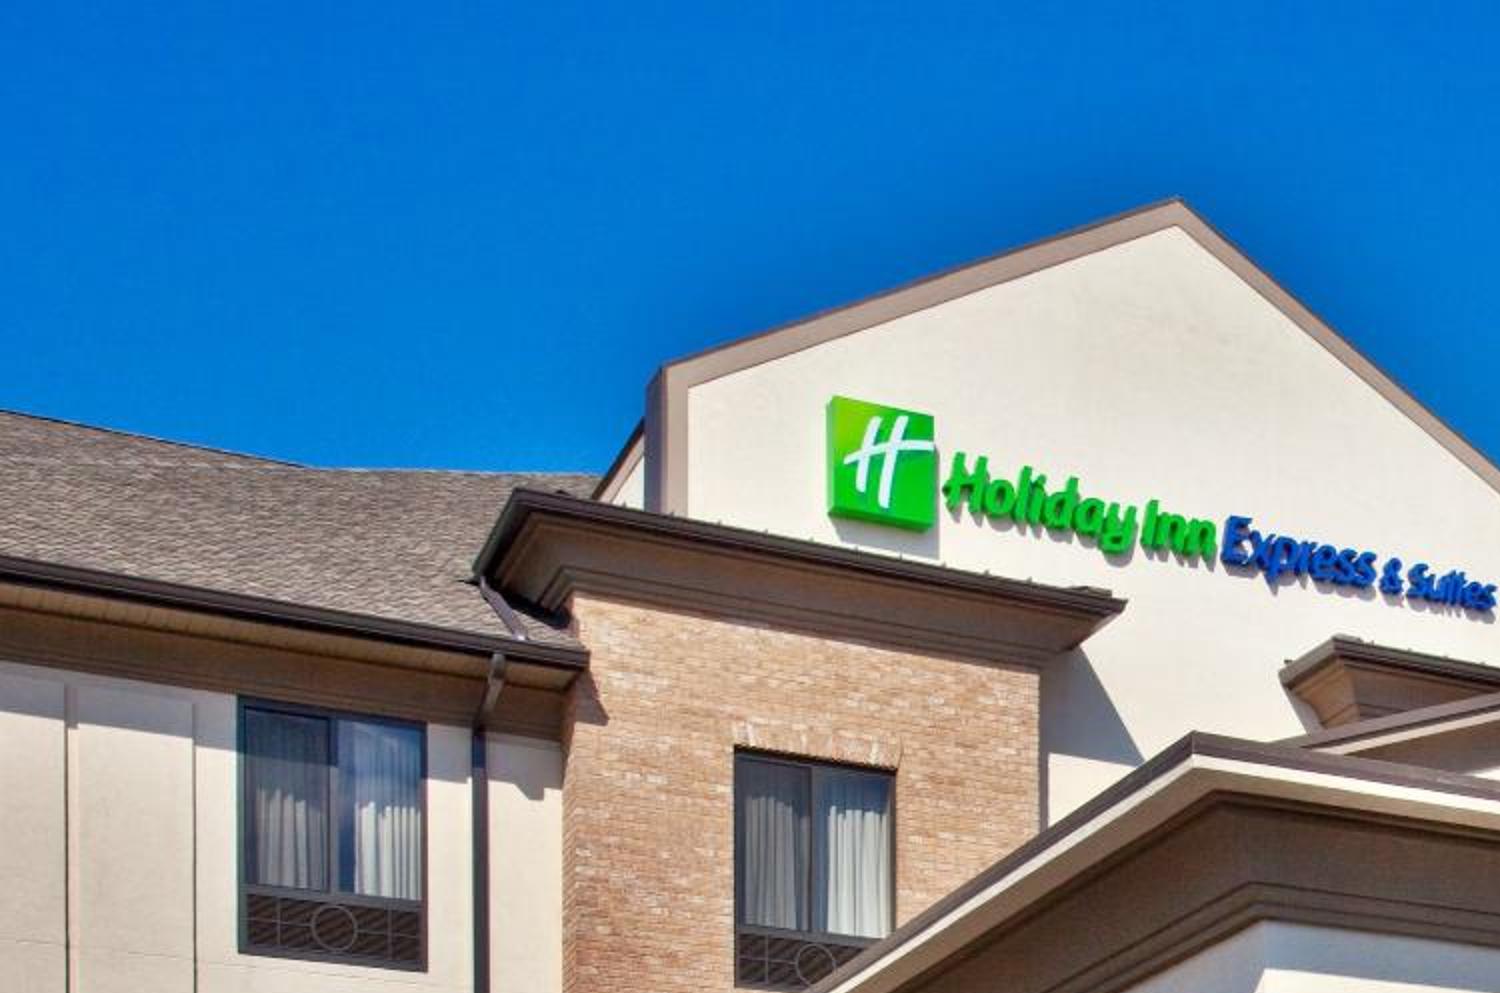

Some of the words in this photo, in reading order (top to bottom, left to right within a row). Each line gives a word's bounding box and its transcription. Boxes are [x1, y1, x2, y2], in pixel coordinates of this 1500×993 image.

[843, 415, 934, 509] H
[943, 452, 1137, 556] Holiday
[1142, 499, 1217, 560] Inn
[1221, 515, 1377, 589] Express
[1380, 557, 1404, 595] &
[1406, 562, 1498, 612] Suites
